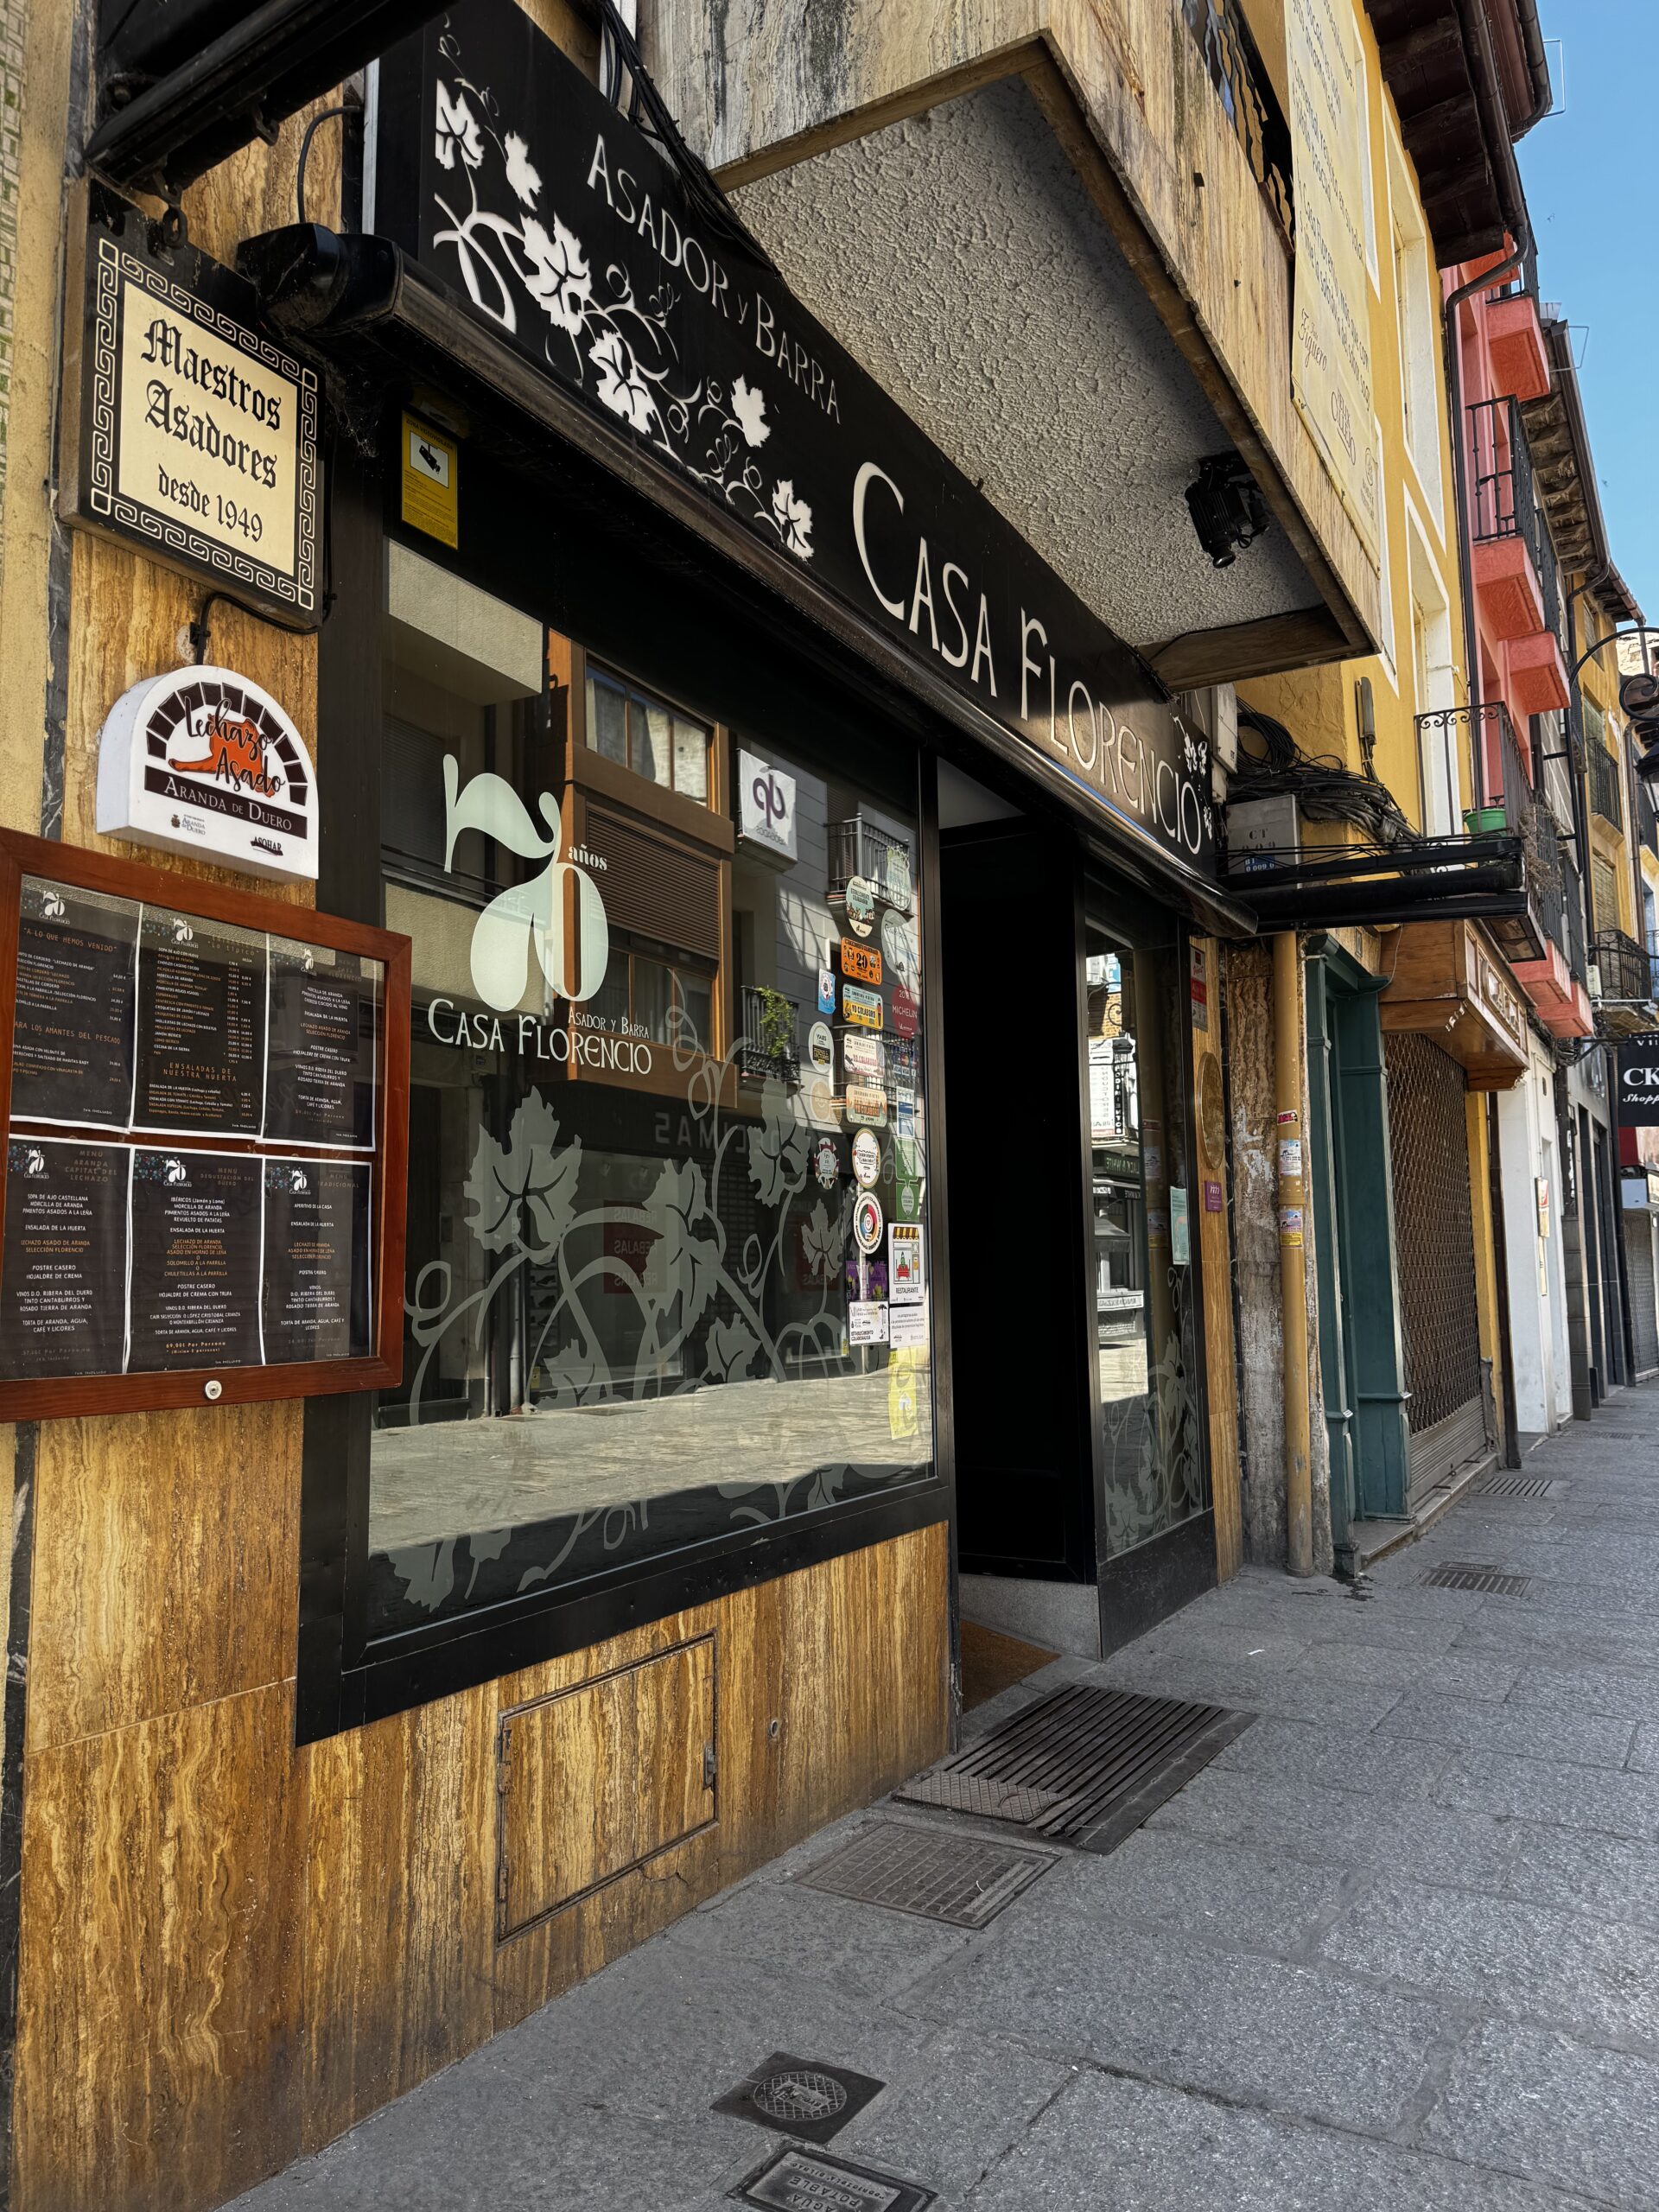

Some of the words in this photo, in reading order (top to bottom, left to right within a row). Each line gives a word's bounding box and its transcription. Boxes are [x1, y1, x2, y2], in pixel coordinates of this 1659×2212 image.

[1303, 181, 1316, 238] Casa
[586, 134, 730, 320] ASADOR
[755, 291, 842, 424] BARRA
[140, 318, 282, 432] Maestros
[144, 380, 278, 490] Asadores
[157, 463, 211, 518] desde
[216, 491, 264, 544] 1949
[853, 461, 998, 699] CASA
[1020, 608, 1203, 856] FLORENCIO
[184, 696, 274, 760] Lechazo
[215, 747, 285, 792] Asado
[164, 776, 227, 811] ARANDA
[232, 804, 243, 815] DE
[249, 802, 292, 831] DUERO
[1249, 828, 1268, 839] CT
[567, 843, 608, 872] años
[46, 933, 58, 941] QUE
[63, 937, 84, 946] HEMOS
[856, 953, 868, 969] 20
[568, 1006, 606, 1031] ASADOR
[621, 1016, 650, 1039] BARRA
[892, 1006, 917, 1019] MICHELIN
[14, 1021, 27, 1029] ARA
[31, 1024, 42, 1032] LOS
[46, 1026, 75, 1037] AMANTES
[95, 1034, 120, 1045] PESCADO
[428, 998, 505, 1053] CASA
[518, 1014, 652, 1075] FLORENCIO
[163, 1069, 200, 1079] NUESTRA
[170, 1062, 215, 1073] ENSALADAS
[789, 2176, 861, 2207] POTABLE
